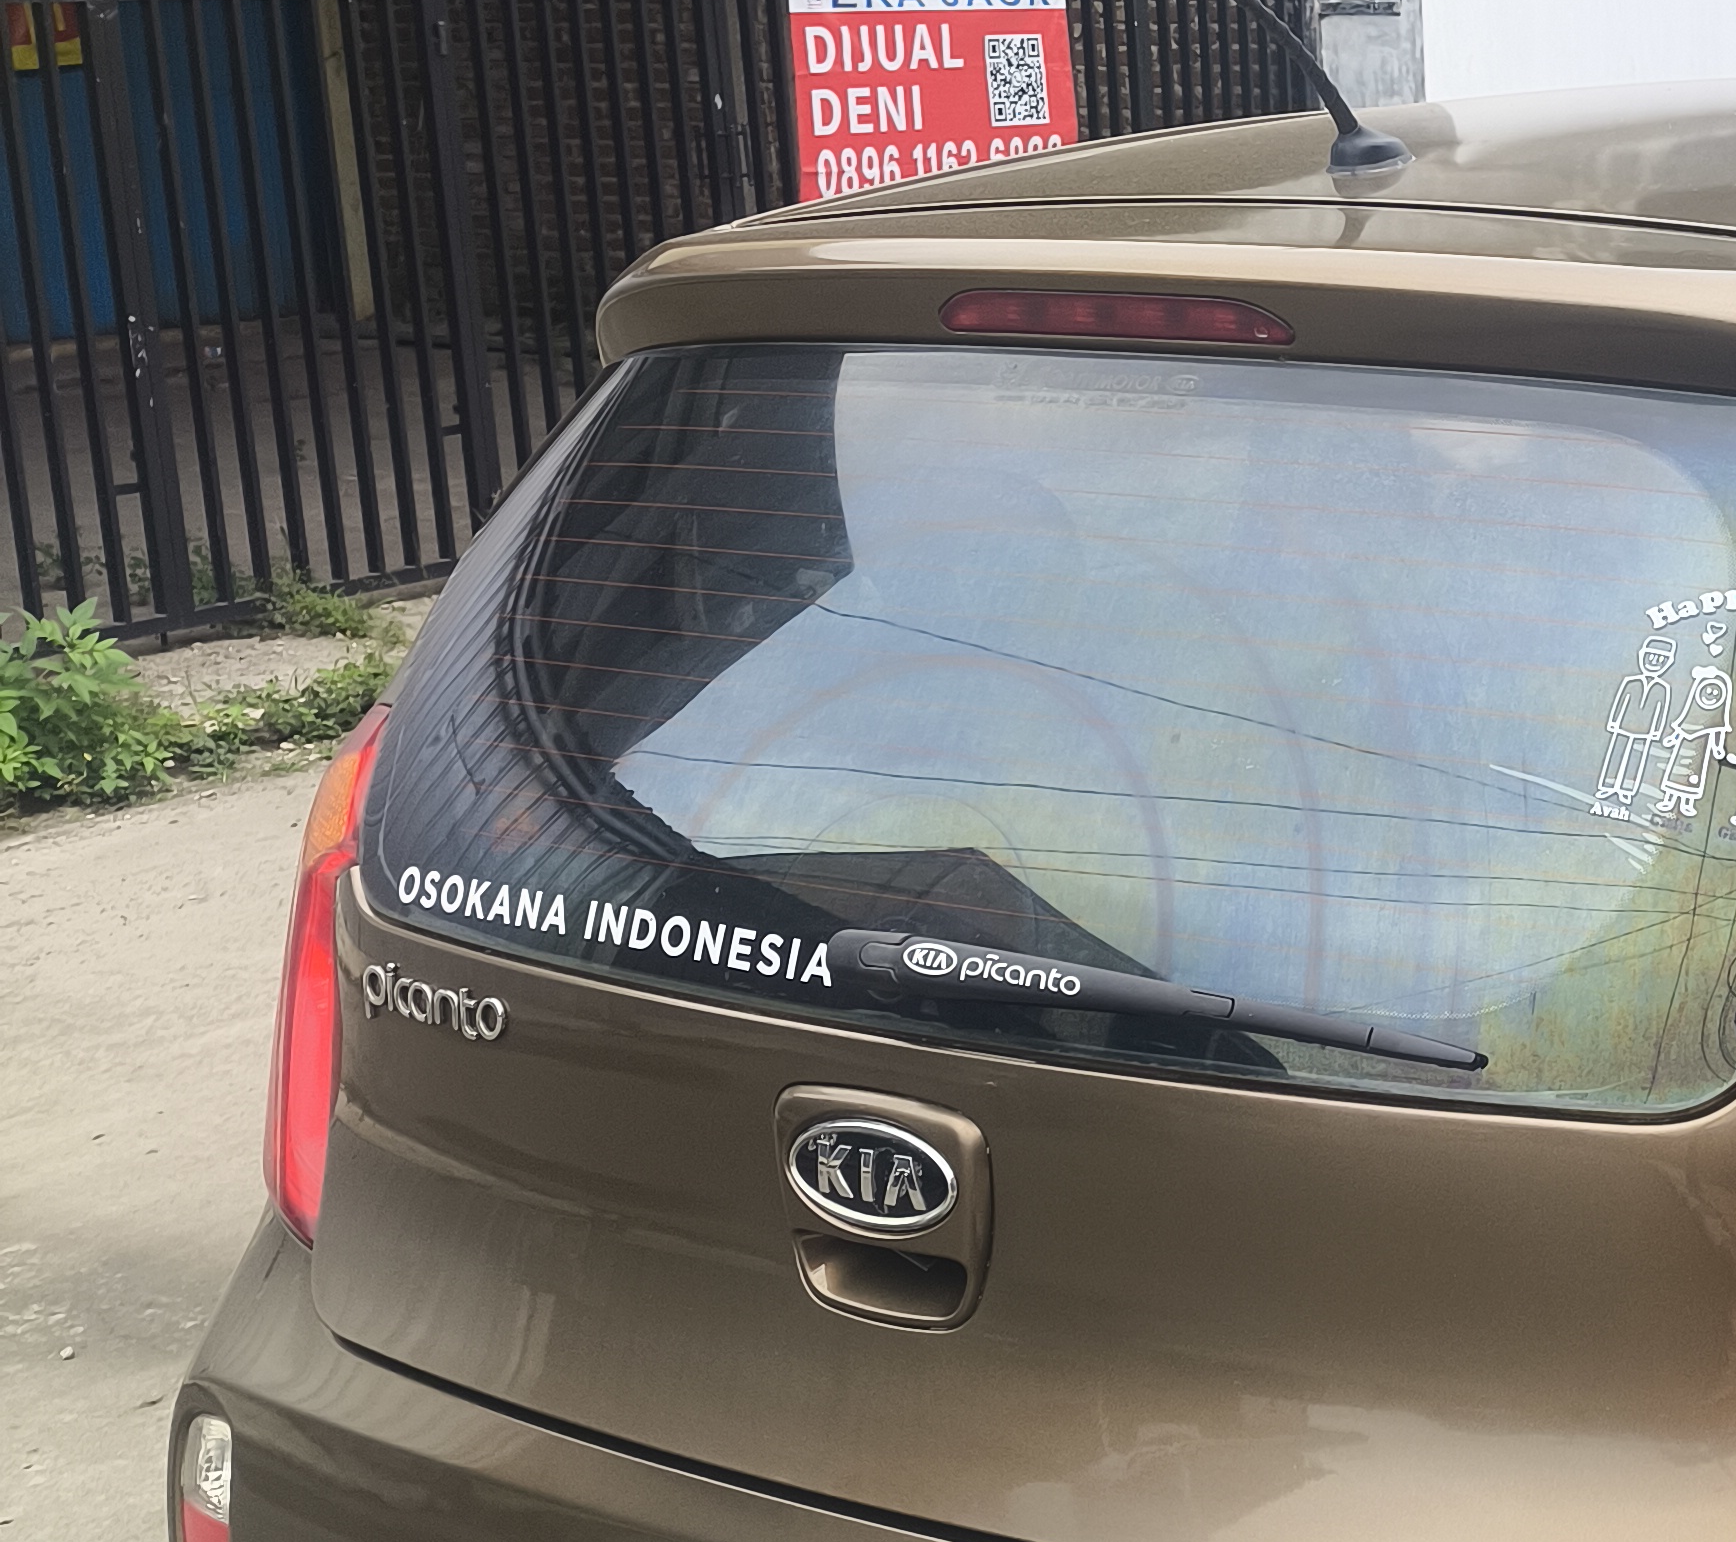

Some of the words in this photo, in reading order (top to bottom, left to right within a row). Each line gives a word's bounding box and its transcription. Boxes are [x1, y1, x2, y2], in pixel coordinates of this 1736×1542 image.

[804, 23, 964, 74] DIJUAL
[811, 84, 922, 136] DENI
[817, 144, 901, 198] 0896
[398, 865, 567, 936] OSOKANA
[583, 900, 833, 987] INDONESIA
[912, 948, 948, 970] KIA
[959, 953, 1081, 996] picanto
[362, 961, 507, 1041] picanto
[816, 1139, 927, 1211] KIA
